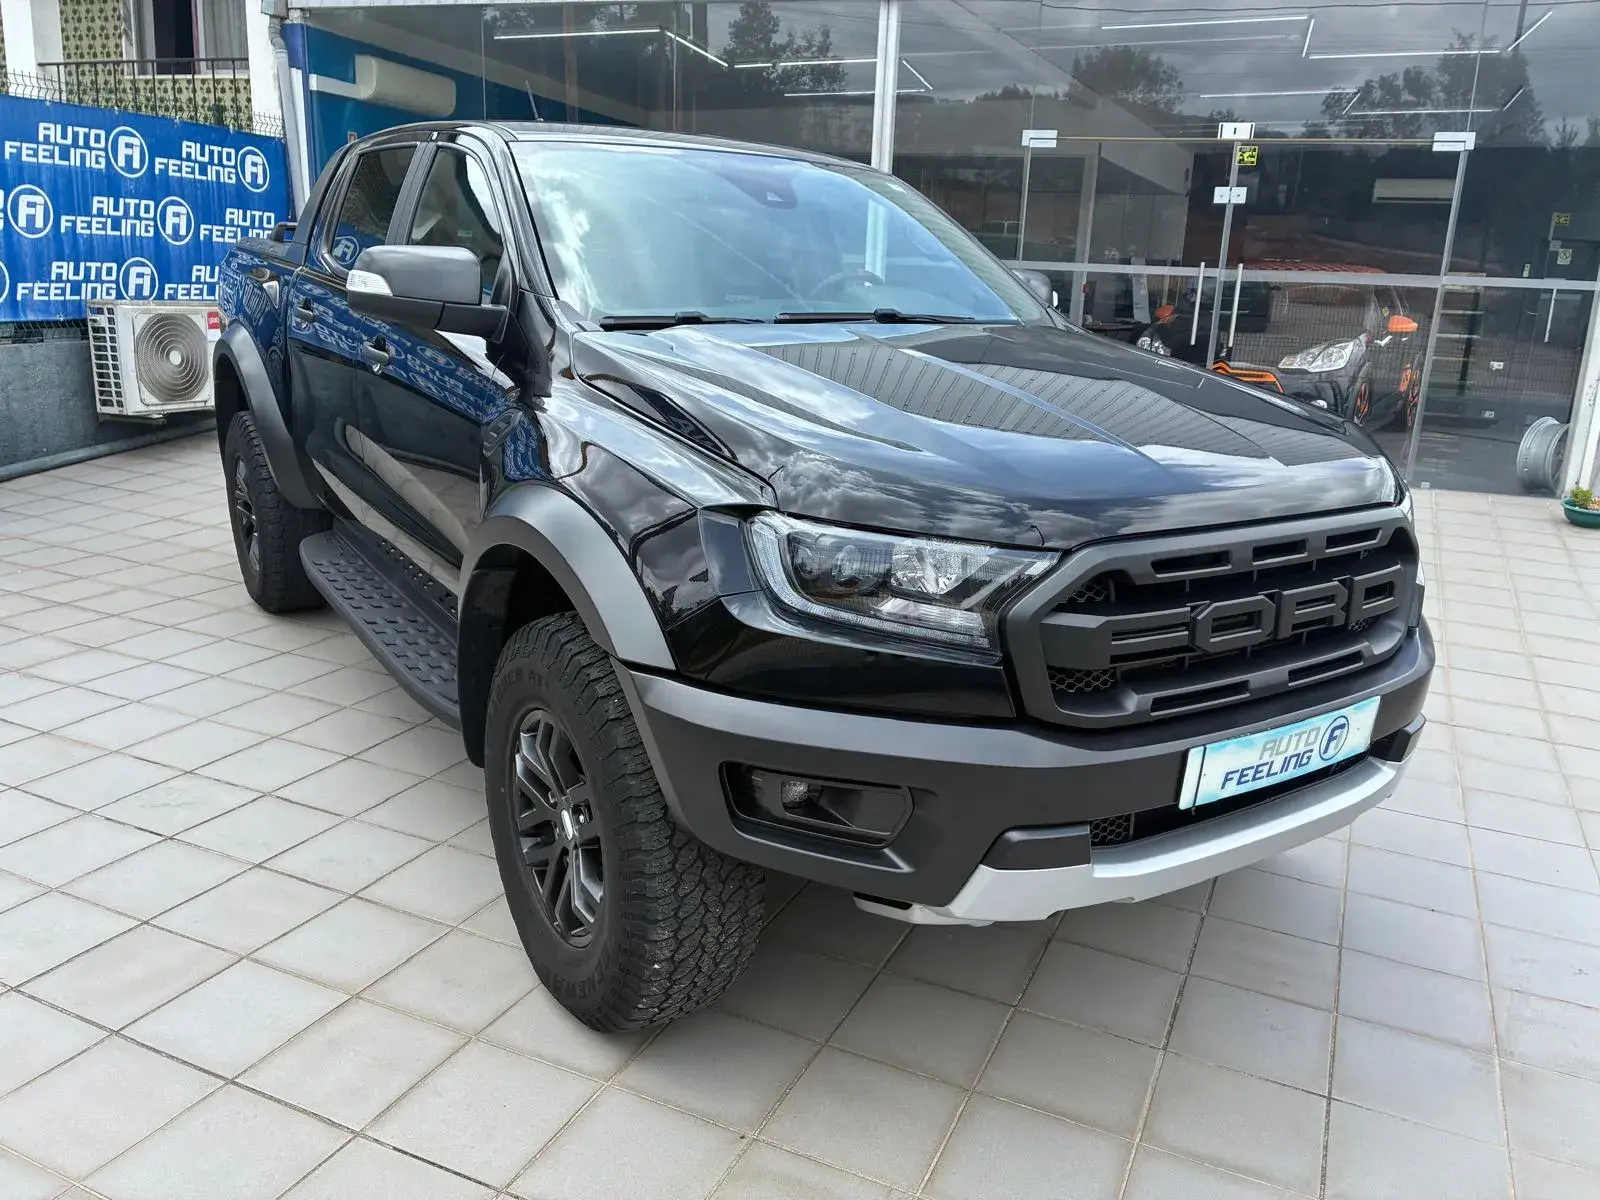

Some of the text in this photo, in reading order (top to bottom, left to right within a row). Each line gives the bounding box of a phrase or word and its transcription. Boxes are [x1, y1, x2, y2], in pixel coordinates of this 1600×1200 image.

[38, 122, 105, 148] AUTO
[5, 140, 105, 169] FEELING
[182, 140, 235, 166] AUTO
[155, 157, 236, 184] FEELING
[92, 196, 154, 218] AUTO
[226, 208, 275, 228] AUTO
[61, 215, 154, 237] FEELING
[200, 224, 272, 243] FEEL
[51, 261, 117, 281] AUTO
[192, 265, 219, 282] AU
[17, 282, 117, 301] FEELING
[164, 284, 219, 300] FEELI
[1070, 566, 1400, 668] FORD
[1259, 725, 1320, 760] AUTO
[1221, 748, 1314, 790] FEELING
